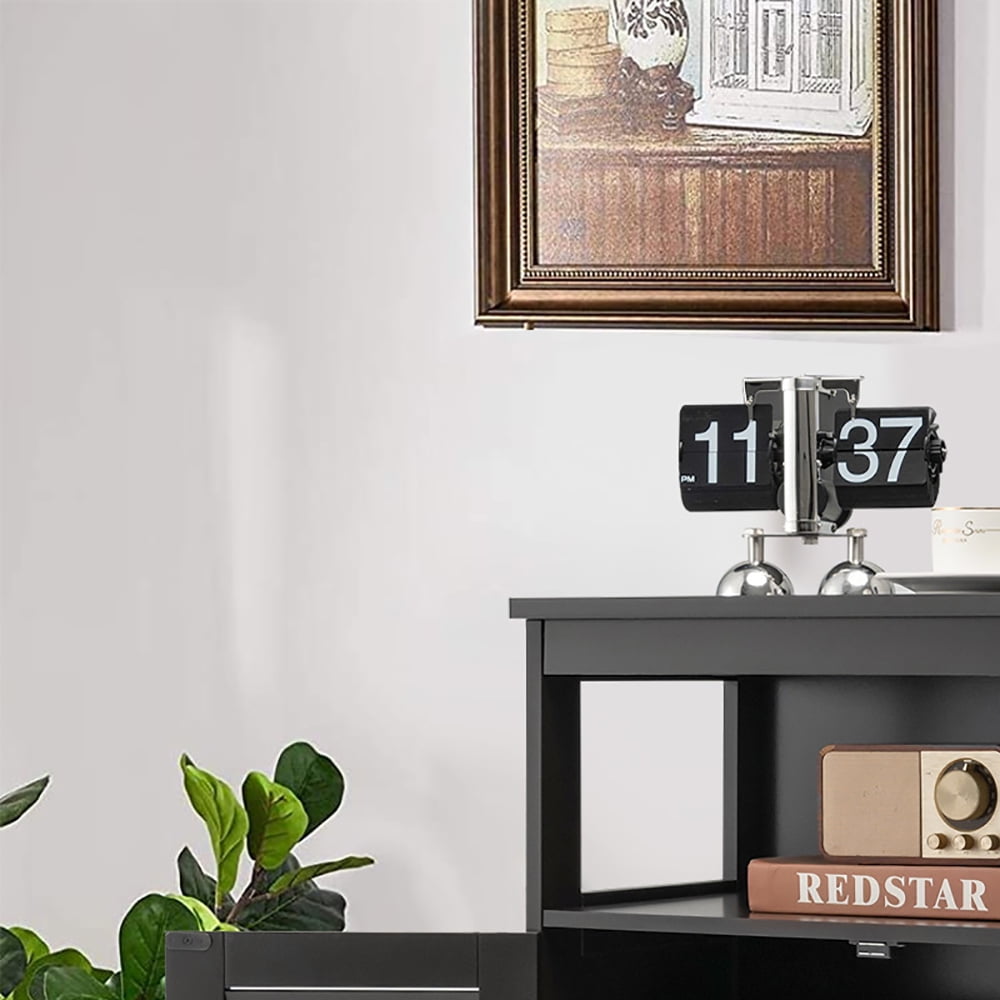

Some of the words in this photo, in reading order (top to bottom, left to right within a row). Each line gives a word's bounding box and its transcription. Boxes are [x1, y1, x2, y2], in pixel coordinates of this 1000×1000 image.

[694, 419, 757, 484] 11
[837, 416, 923, 484] 37
[680, 475, 696, 483] PM
[795, 871, 989, 912] REDSTAR
